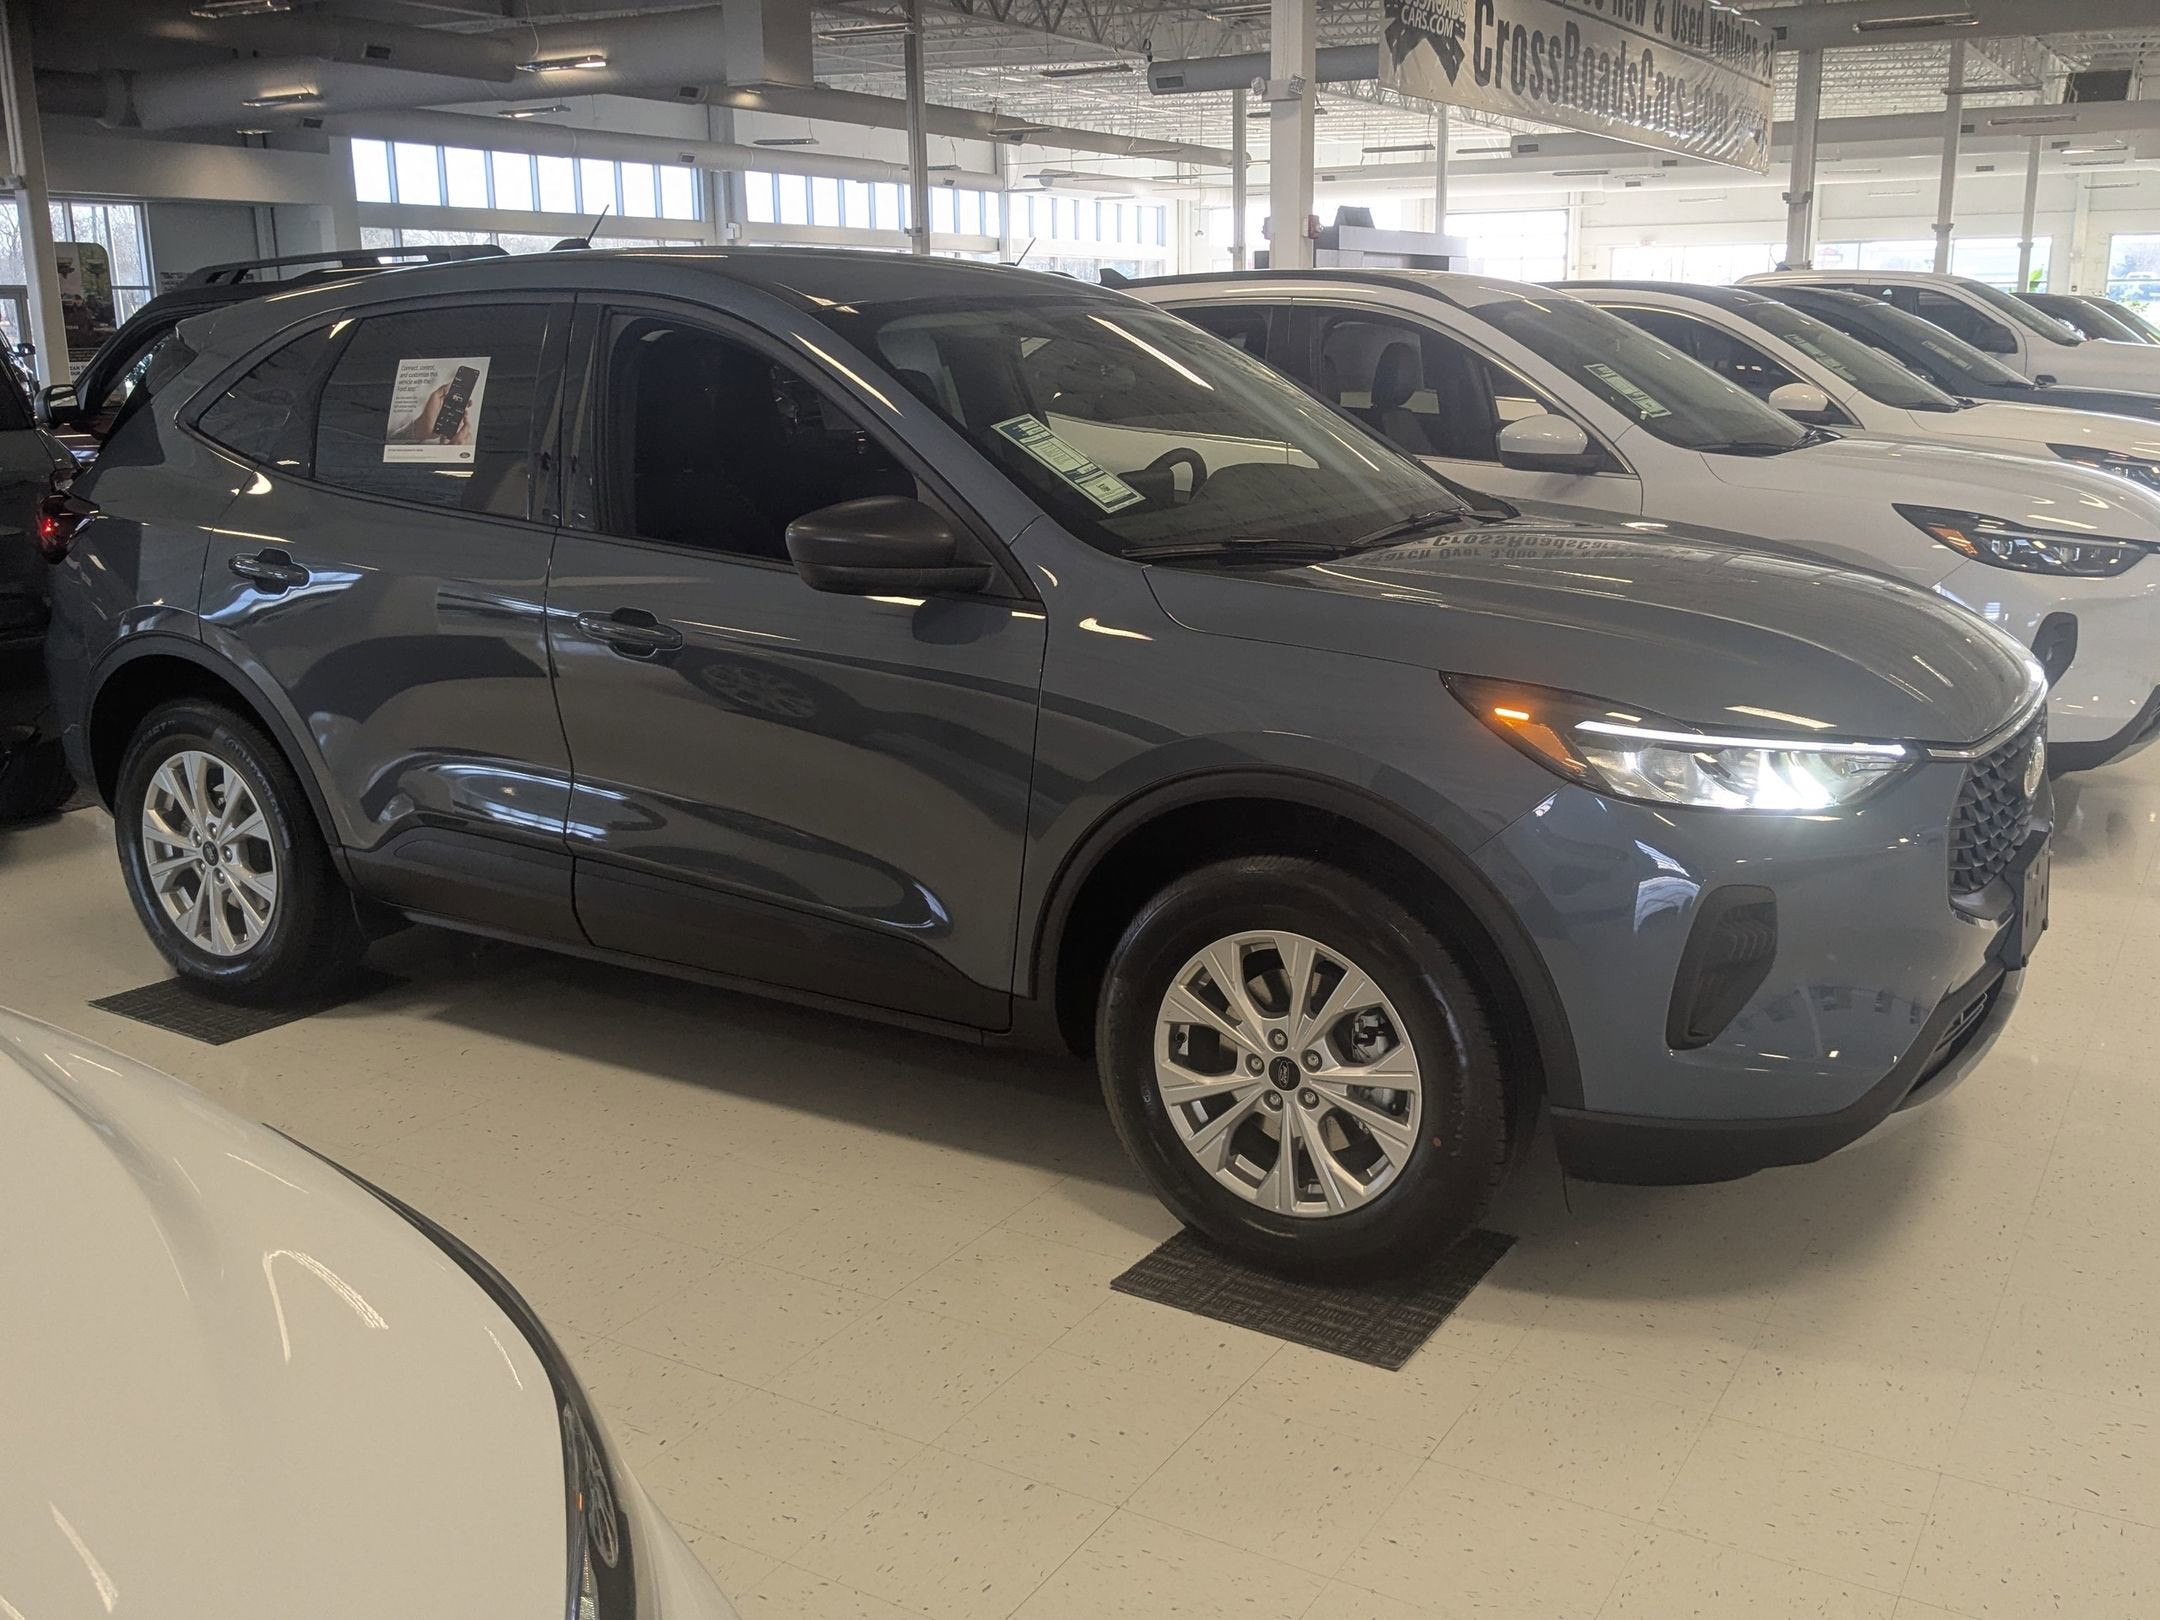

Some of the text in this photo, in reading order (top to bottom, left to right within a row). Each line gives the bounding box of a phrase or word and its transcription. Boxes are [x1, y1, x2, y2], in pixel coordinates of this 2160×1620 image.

[1401, 5, 1454, 38] CARS.COM
[1654, 0, 1665, 34] &
[1671, 0, 1704, 49] Used
[1710, 6, 1758, 73] Vehicles
